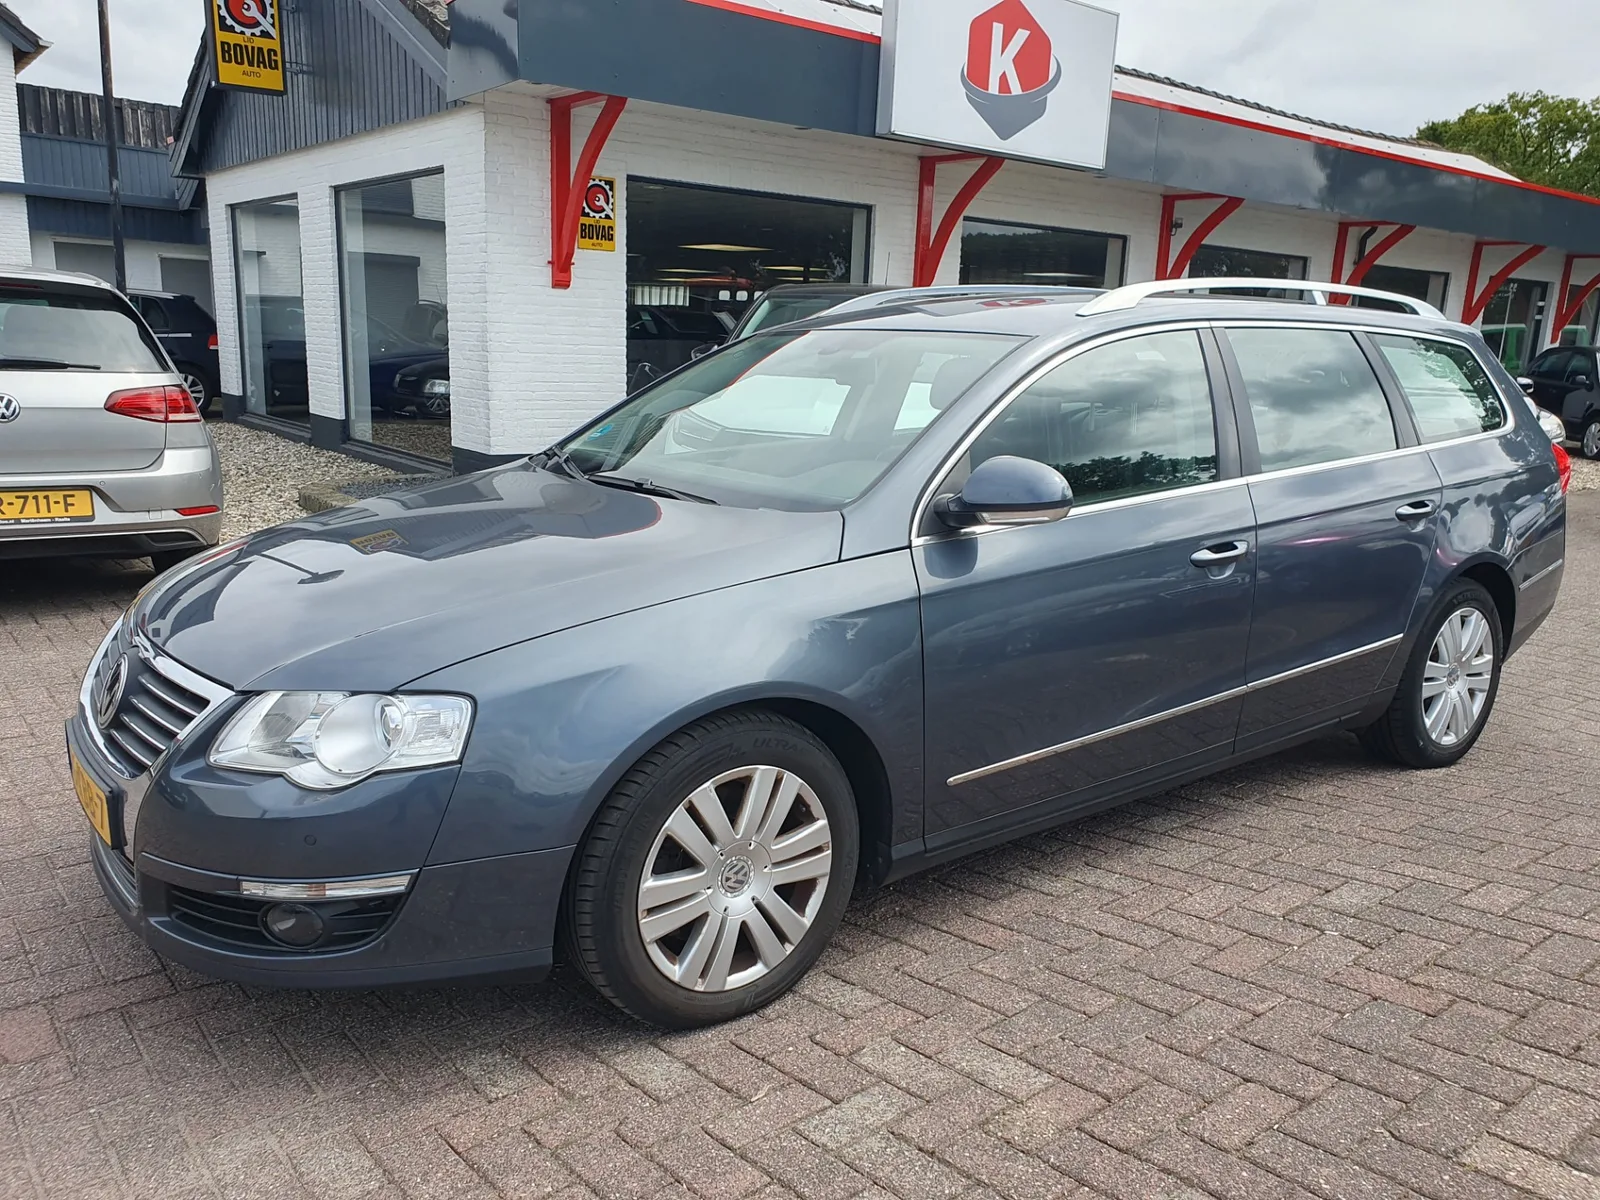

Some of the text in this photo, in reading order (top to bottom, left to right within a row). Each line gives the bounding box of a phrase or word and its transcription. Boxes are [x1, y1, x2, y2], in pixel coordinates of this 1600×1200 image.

[243, 36, 255, 44] LID
[220, 40, 279, 71] BOVAG
[988, 21, 1031, 95] K
[242, 70, 261, 79] AUTO
[580, 223, 614, 241] BOVAG
